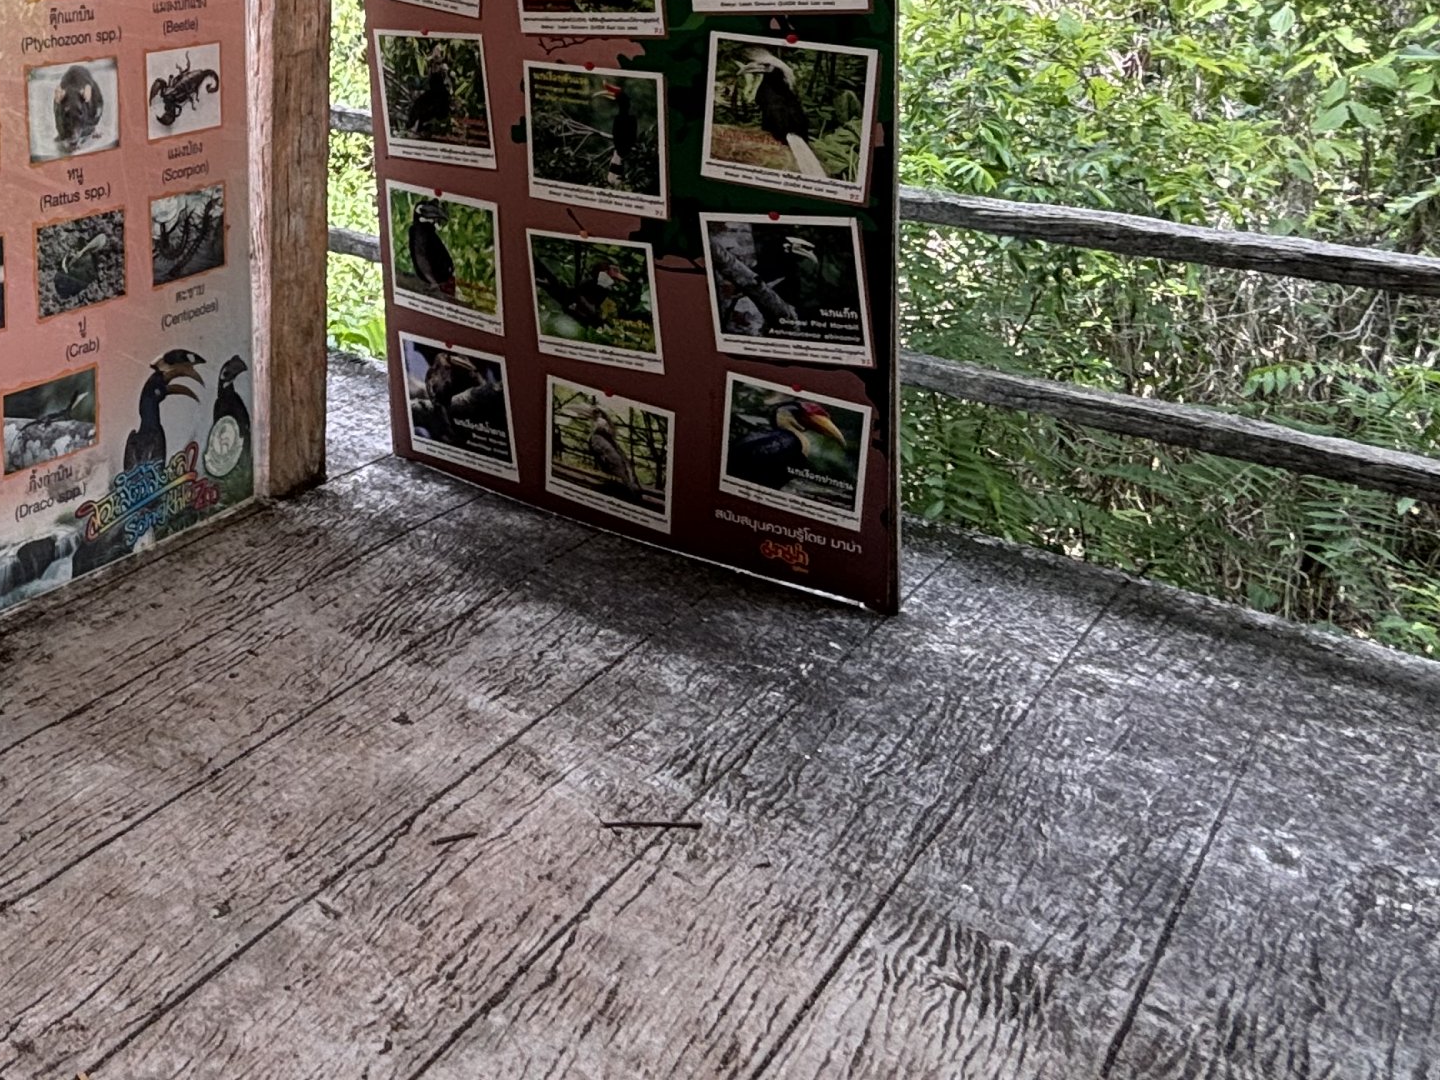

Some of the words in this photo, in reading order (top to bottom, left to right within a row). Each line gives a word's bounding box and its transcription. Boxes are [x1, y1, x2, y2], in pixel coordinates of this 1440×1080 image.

[162, 18, 199, 36] (Beetle)
[21, 31, 92, 54] (Ptychozoon
[95, 26, 122, 44] spp.)
[162, 160, 209, 185] (Scorpion)
[39, 191, 80, 212] (Rattus
[84, 183, 111, 201] spp.)
[161, 298, 219, 330] (Centipedes)
[65, 337, 100, 360] (Crab)
[14, 497, 54, 522] (Draco
